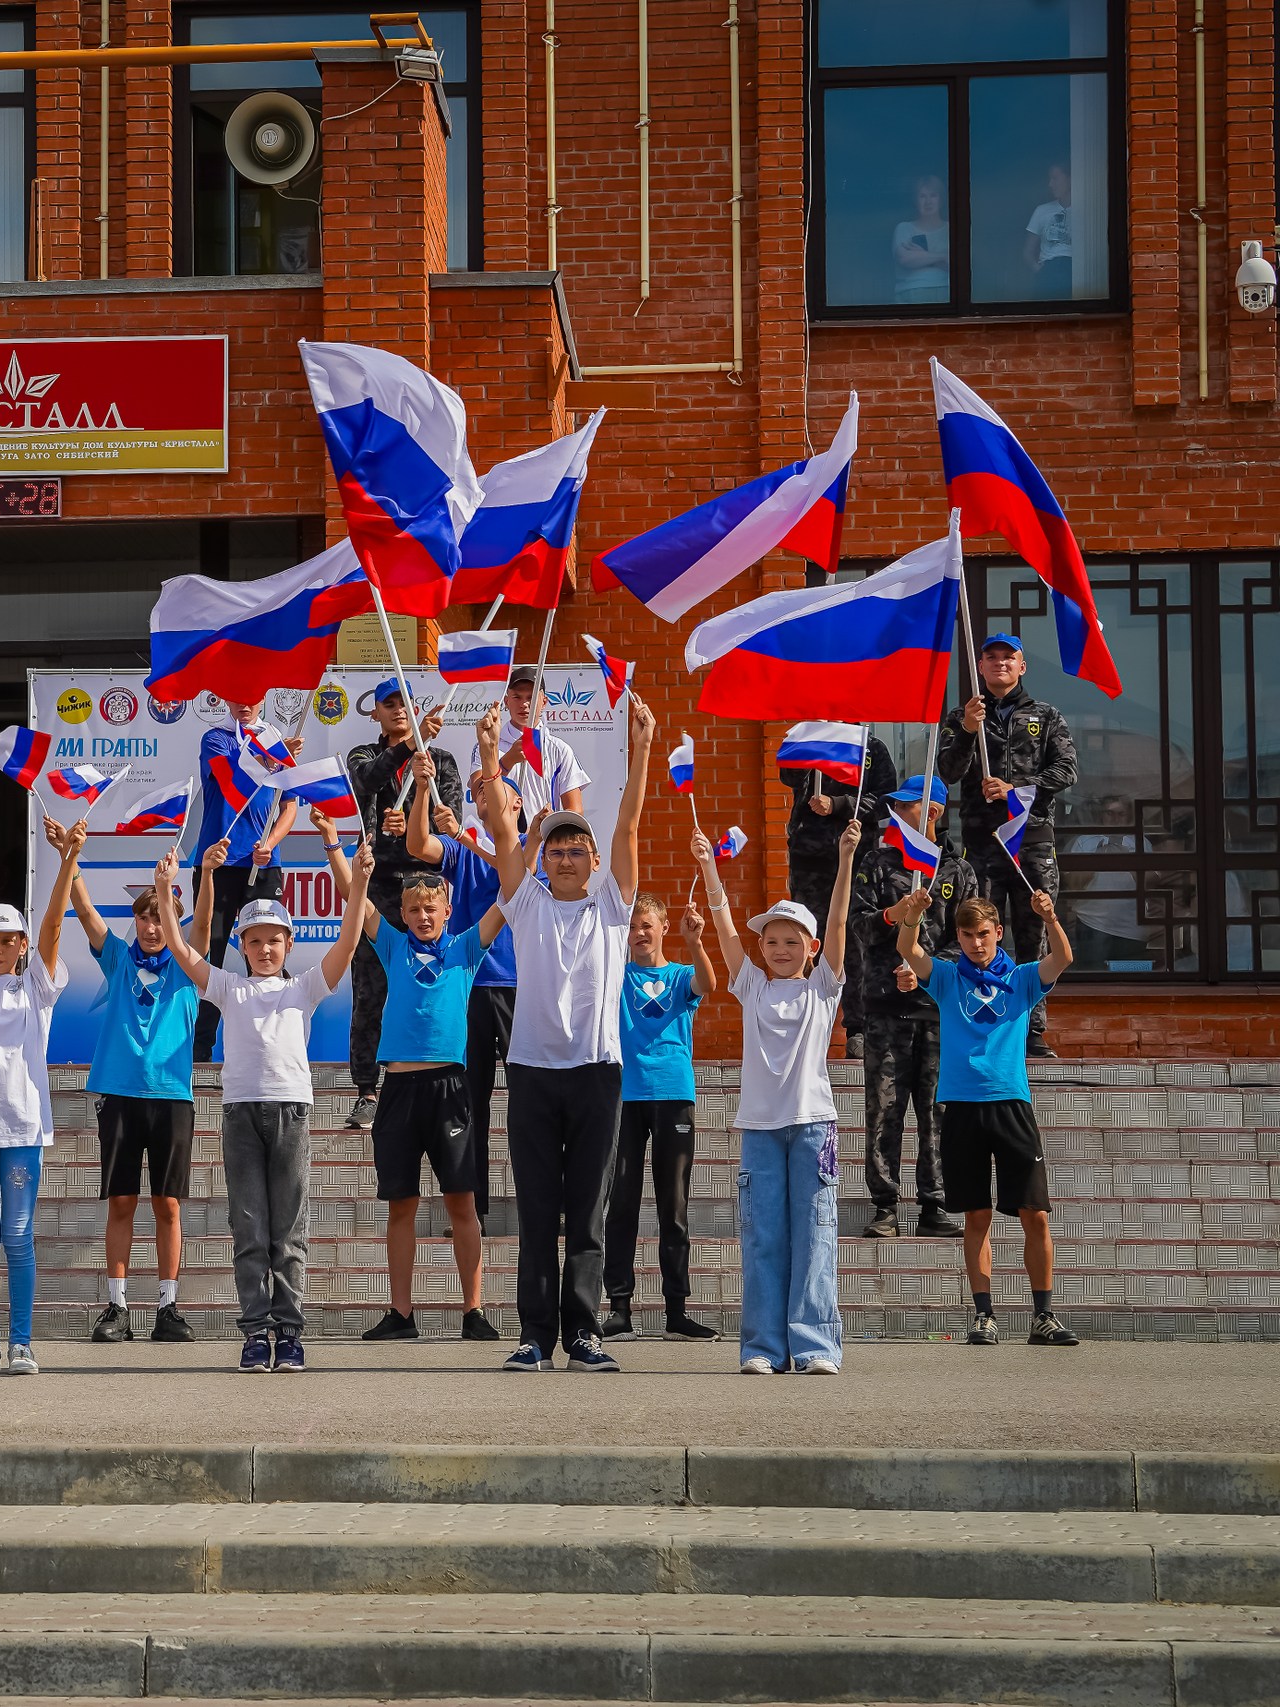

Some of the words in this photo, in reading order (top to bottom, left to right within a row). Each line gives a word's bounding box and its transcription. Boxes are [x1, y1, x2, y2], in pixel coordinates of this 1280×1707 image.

[31, 442, 80, 450] КУЛЬТУРЫ
[83, 442, 104, 450] ДОМ
[107, 441, 158, 449] КУЛЬТУРЫ
[24, 452, 51, 460] ЗАТО
[56, 450, 119, 459] СИБИРСКИЙ
[546, 710, 613, 721] ИСТАЛЛ
